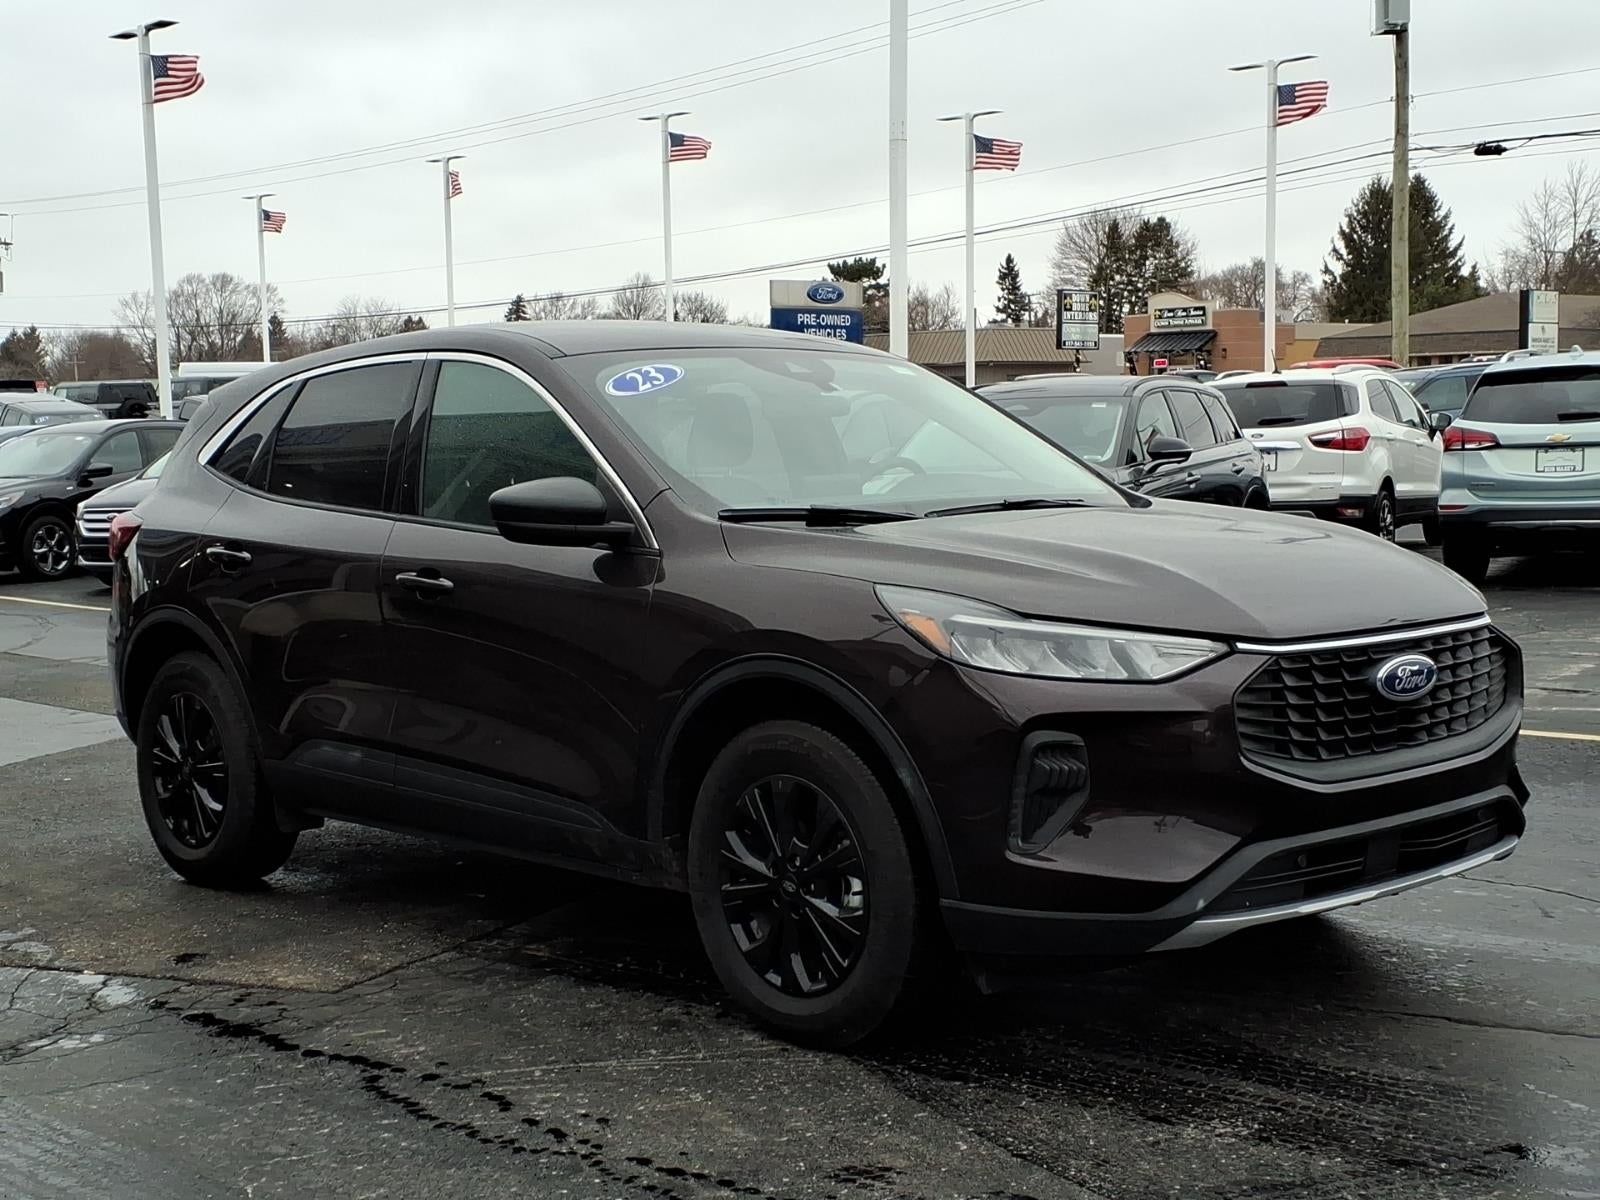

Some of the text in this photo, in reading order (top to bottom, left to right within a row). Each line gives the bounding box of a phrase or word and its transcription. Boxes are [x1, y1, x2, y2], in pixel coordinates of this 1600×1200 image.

[816, 287, 838, 300] Ford
[797, 313, 851, 326] PRE-OWNED
[626, 367, 665, 391] 23
[1395, 664, 1428, 691] Ford
